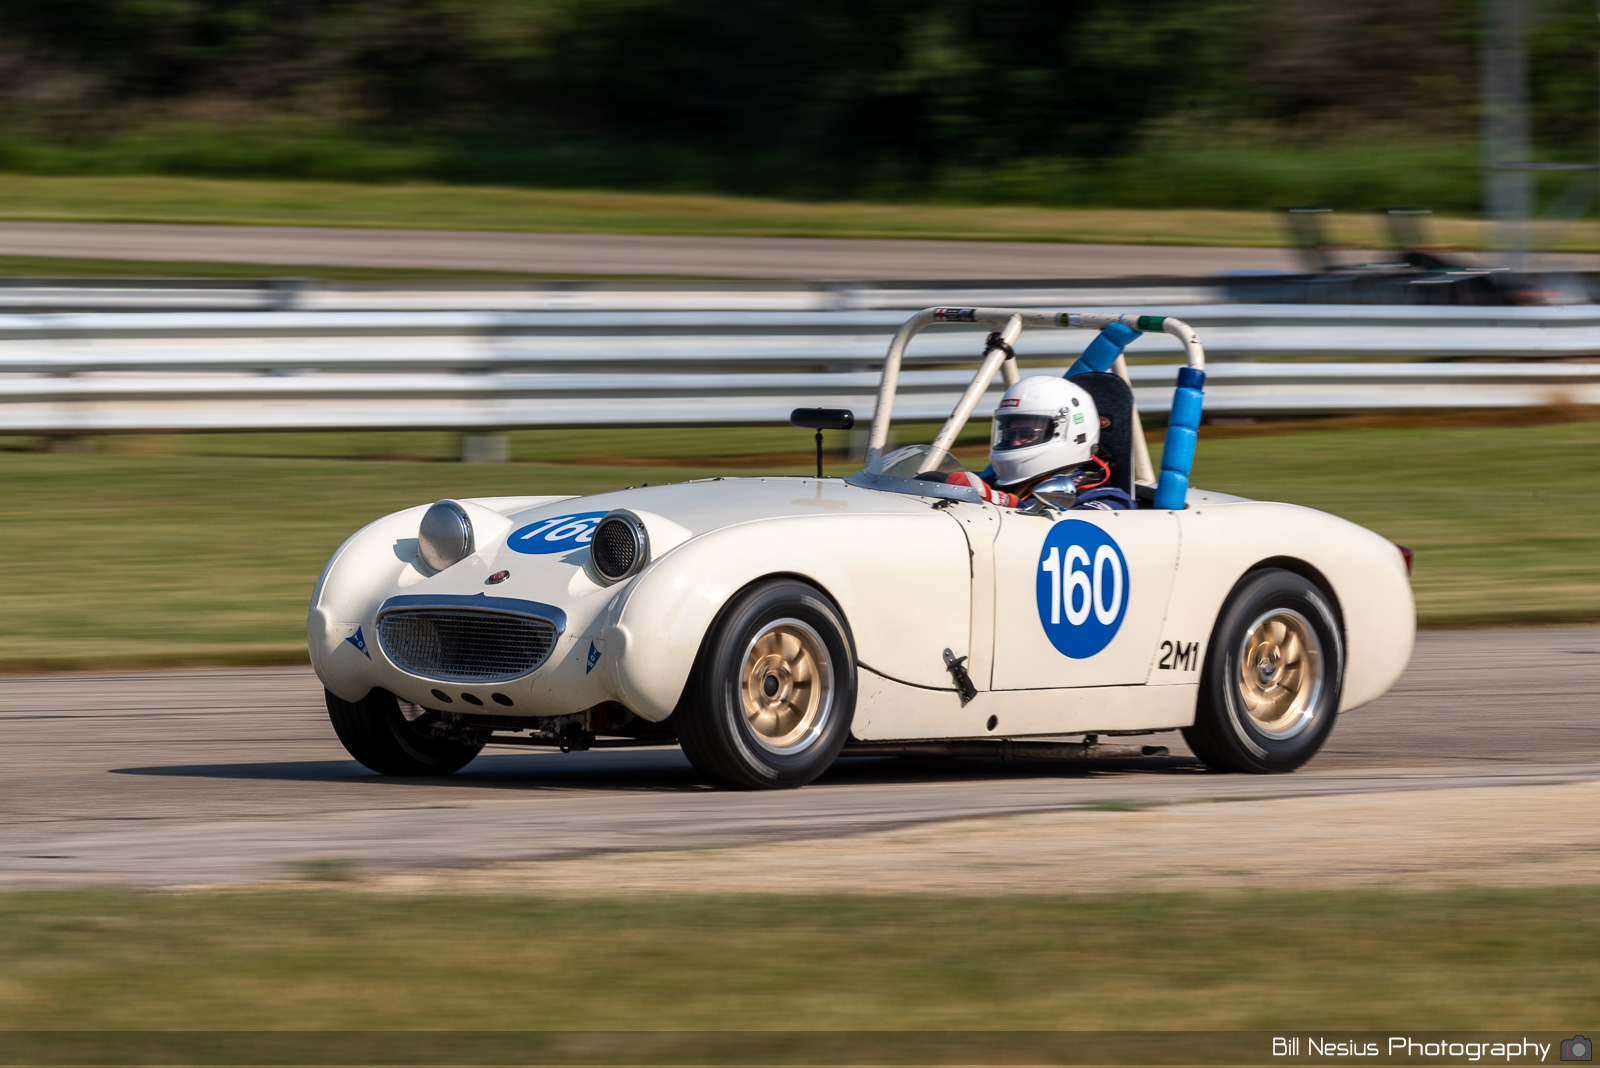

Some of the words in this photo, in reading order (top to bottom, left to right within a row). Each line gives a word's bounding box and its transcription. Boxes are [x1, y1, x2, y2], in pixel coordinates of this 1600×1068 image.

[1042, 544, 1123, 626] 160
[353, 634, 368, 654] TOW
[1158, 640, 1199, 671] 2M1
